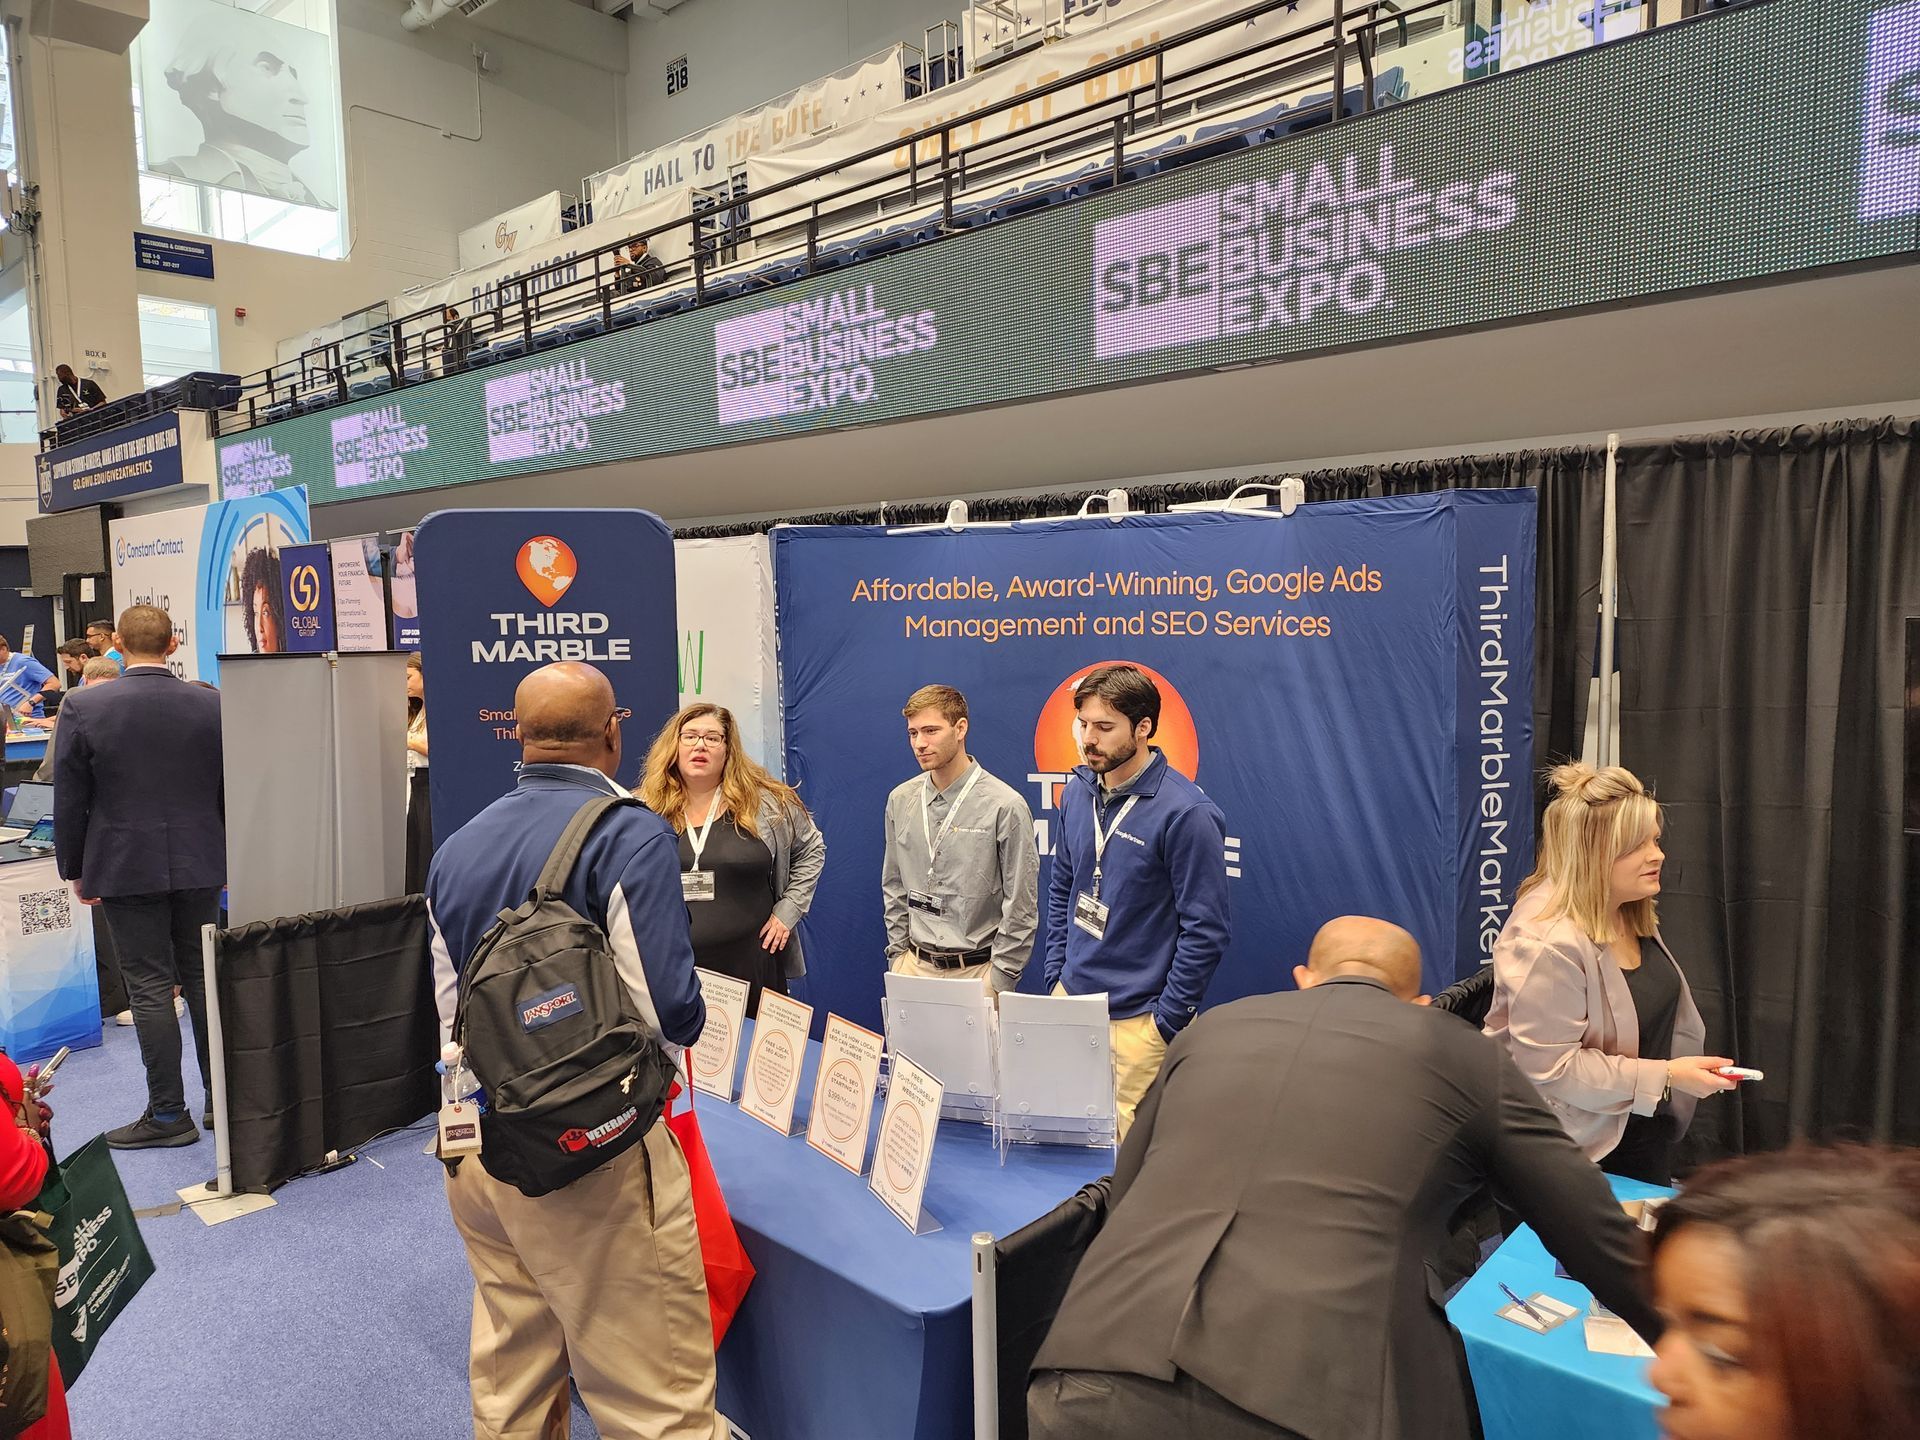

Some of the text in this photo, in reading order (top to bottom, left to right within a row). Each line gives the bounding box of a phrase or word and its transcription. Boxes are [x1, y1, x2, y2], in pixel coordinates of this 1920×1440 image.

[666, 56, 688, 74] SECTION
[667, 66, 688, 95] 218
[893, 31, 1160, 169] ONLY AT GW
[644, 98, 822, 195] HAIL TO THE BUFF
[1222, 141, 1414, 233] SMALL
[1102, 171, 1517, 313] SBE BUSINESS
[531, 250, 578, 294] HIGH
[783, 285, 884, 341] SMALL
[85, 350, 100, 358] BOX
[720, 310, 937, 391] SBE BUSINESS
[529, 358, 593, 401] SMALL
[361, 405, 406, 433] SMALL
[490, 381, 625, 437] SBE BUSINESS
[335, 424, 429, 466] SBE BUSINESS
[126, 537, 184, 558] Constant Contact
[851, 563, 1383, 603] Affordable, Award-Winning, Google Ads
[157, 595, 170, 612] up
[292, 616, 321, 628] GLOBAL
[490, 612, 609, 636] THIRD
[904, 609, 1332, 643] Management and SEO Services
[471, 638, 631, 663] MARBLE
[167, 655, 187, 682] ing.
[479, 708, 517, 722] Smal
[493, 727, 518, 740] Thi
[724, 987, 742, 996] GOOGLE
[523, 991, 577, 1024] JANSPORT
[702, 1031, 718, 1040] ARTING
[860, 1040, 875, 1052] LOCAL
[840, 1047, 862, 1062] BUSINESS
[831, 1077, 852, 1092] STARTING
[834, 1071, 858, 1087] LOCAL SEO
[897, 1072, 934, 1103] DO-IT-YOURSELF
[911, 1072, 923, 1085] FREE
[584, 1106, 637, 1141] VETERANS
[74, 1218, 92, 1241] ALL
